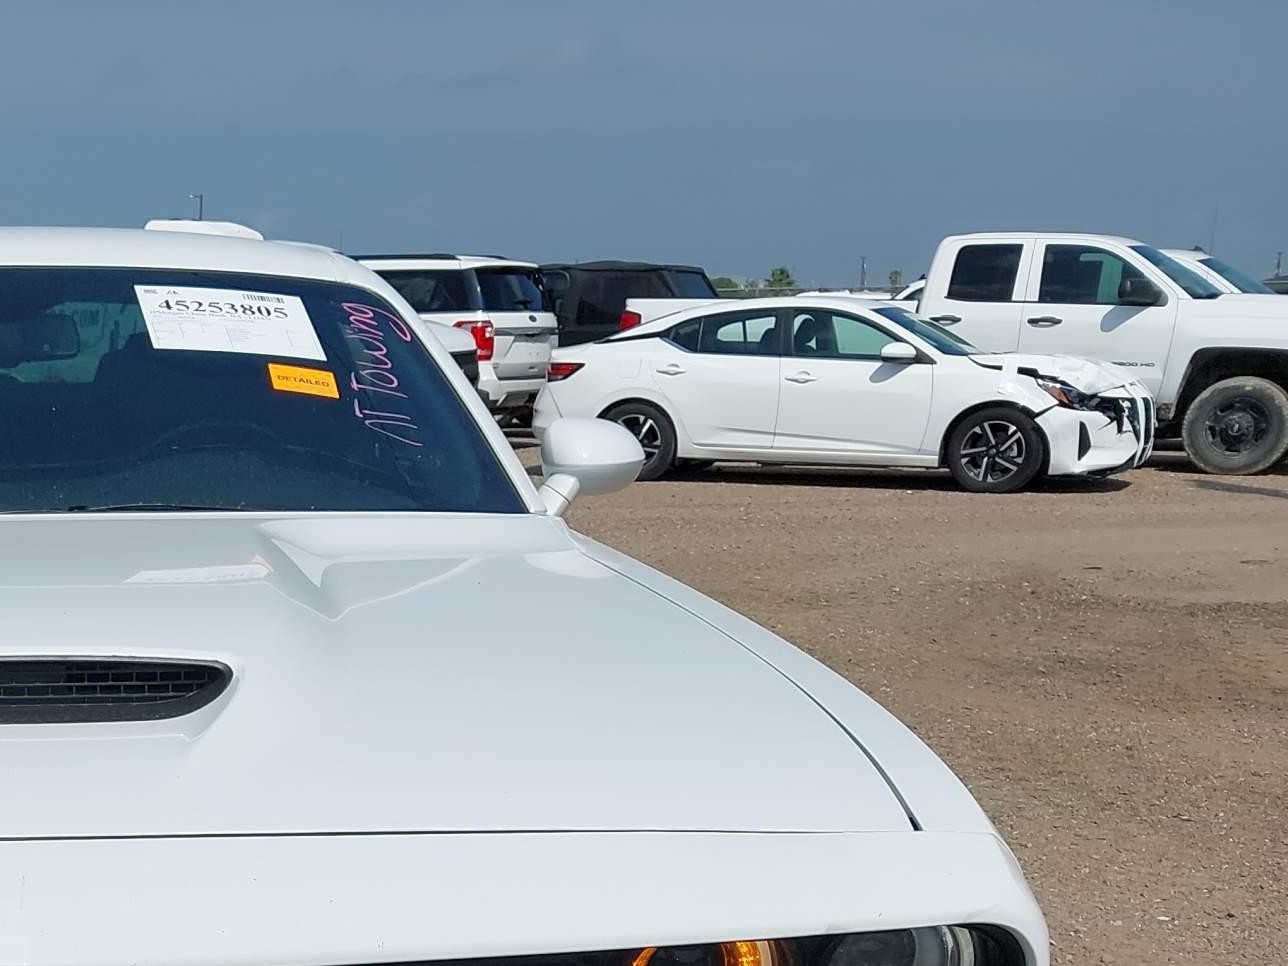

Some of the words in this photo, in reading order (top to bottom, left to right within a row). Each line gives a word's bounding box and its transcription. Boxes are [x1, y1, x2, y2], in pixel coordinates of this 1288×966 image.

[158, 298, 289, 319] 45253805
[341, 302, 412, 398] Towing
[277, 374, 330, 387] DETAILED
